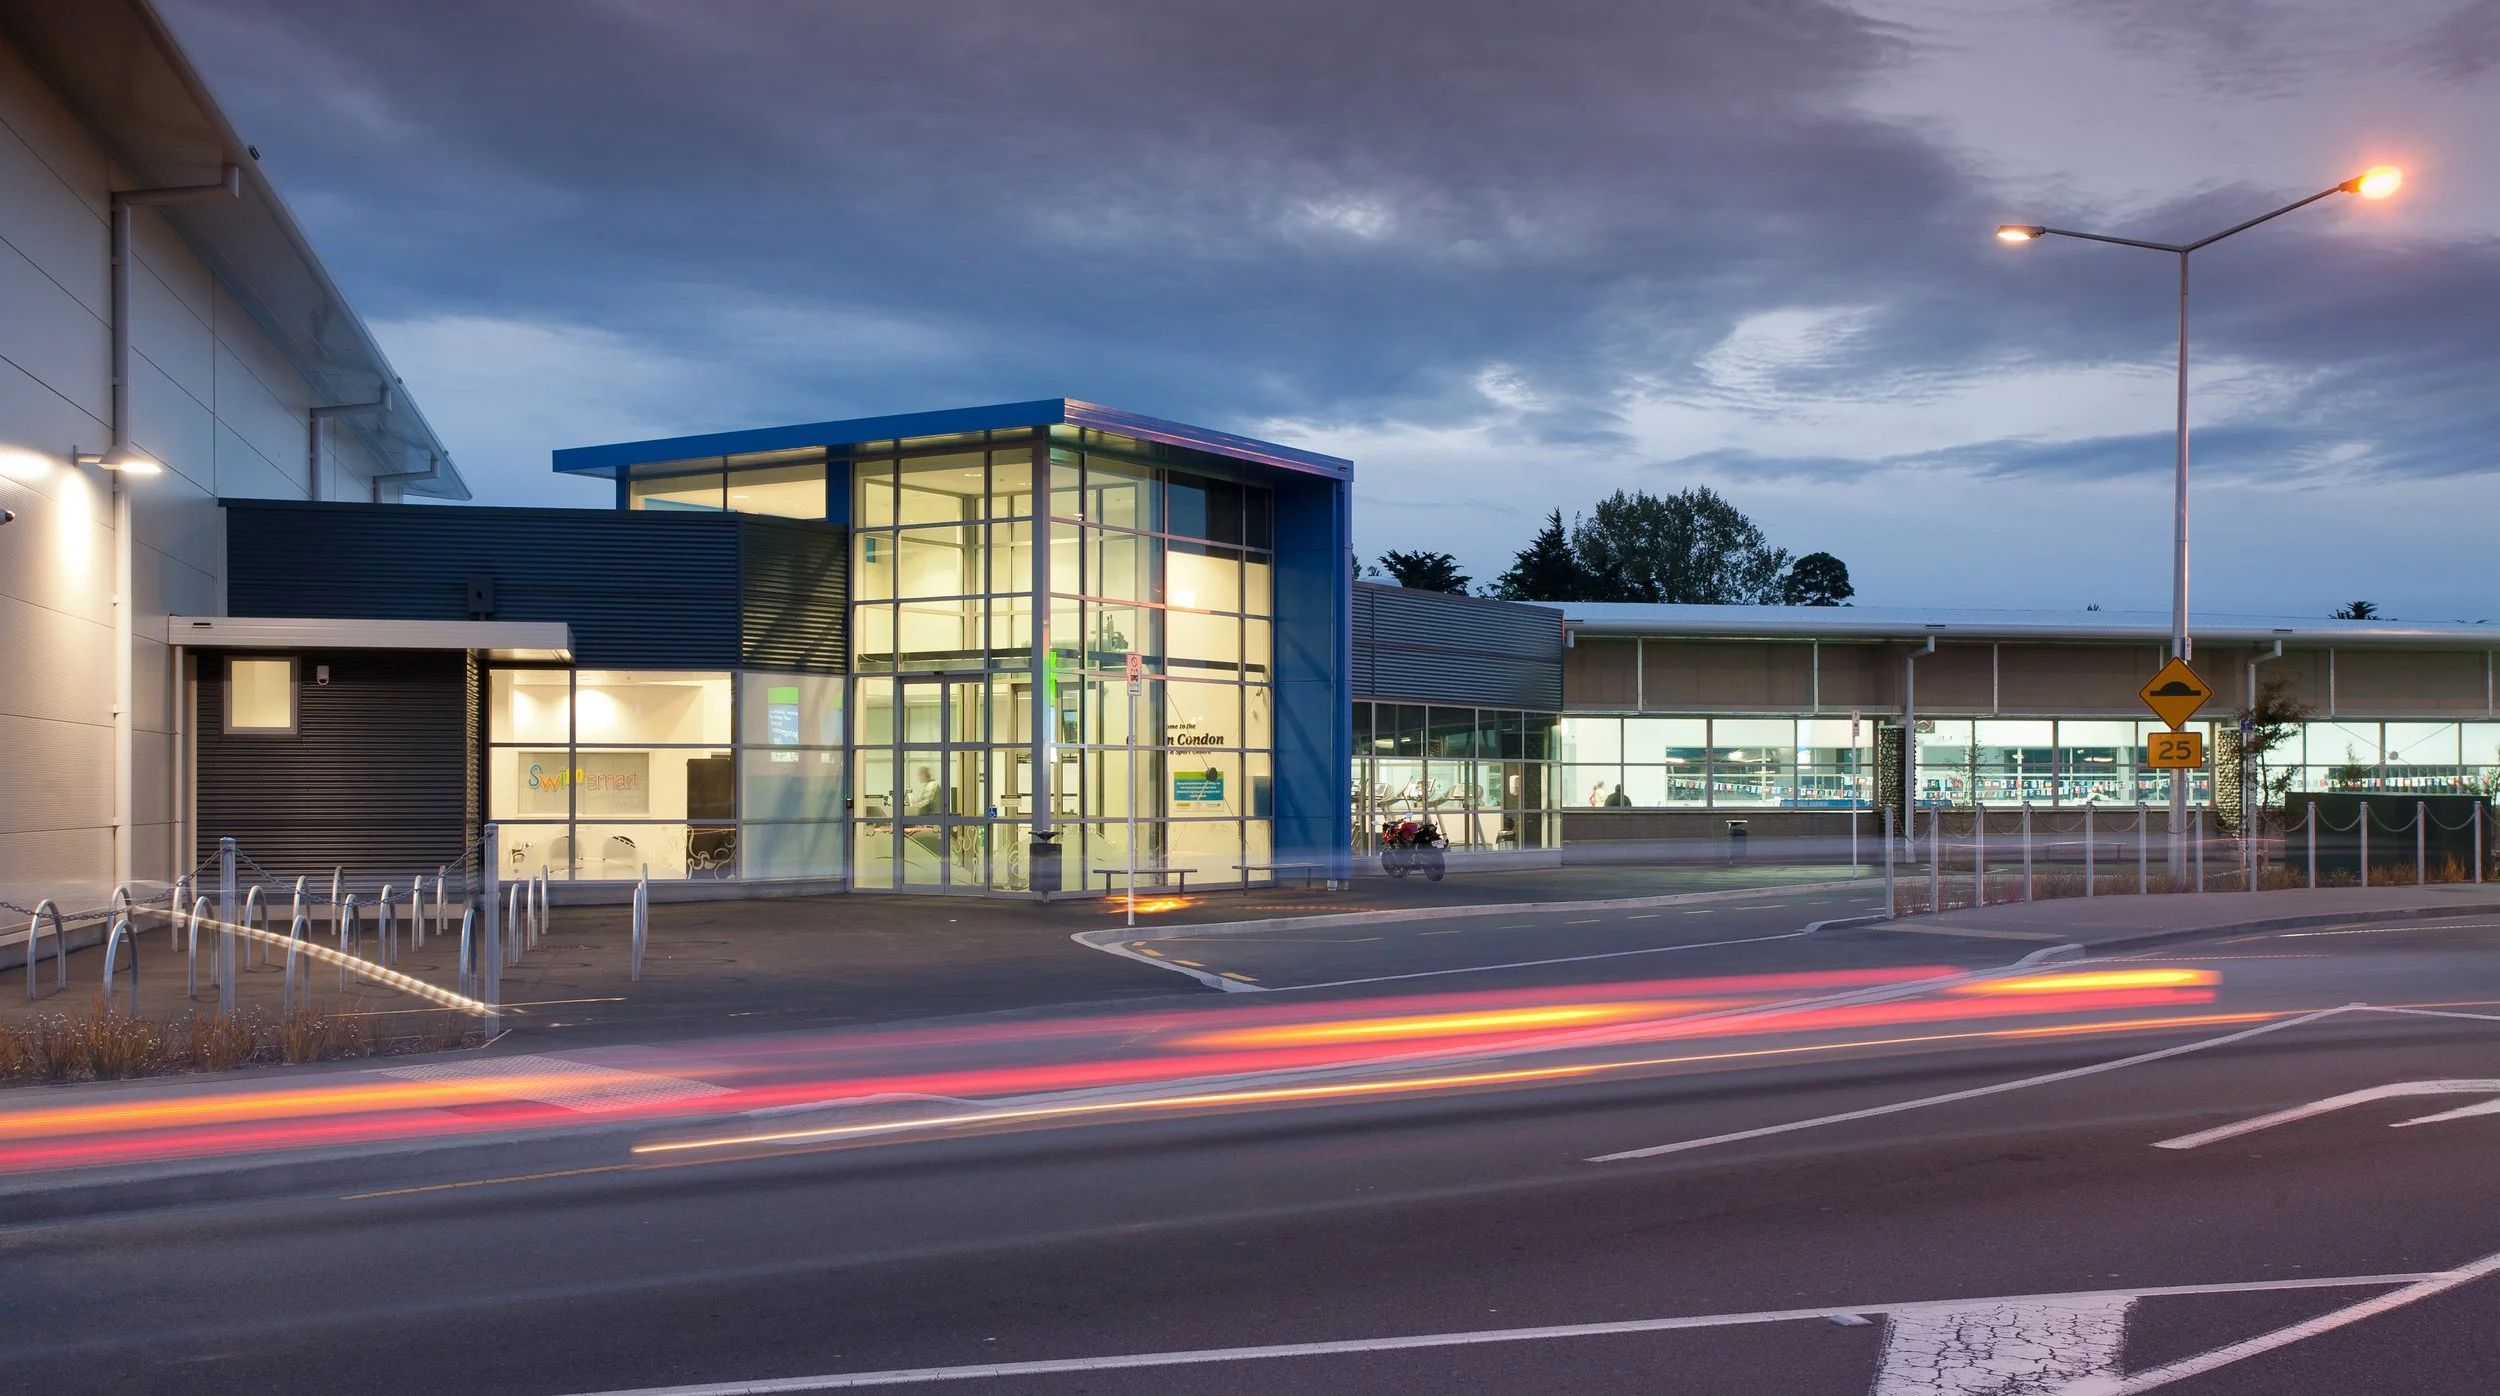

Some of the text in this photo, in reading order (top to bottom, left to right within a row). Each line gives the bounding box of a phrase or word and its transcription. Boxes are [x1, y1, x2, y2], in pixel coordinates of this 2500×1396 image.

[1177, 732, 1225, 746] Condon
[2158, 740, 2192, 761] 25
[528, 763, 640, 792] Swim smart
